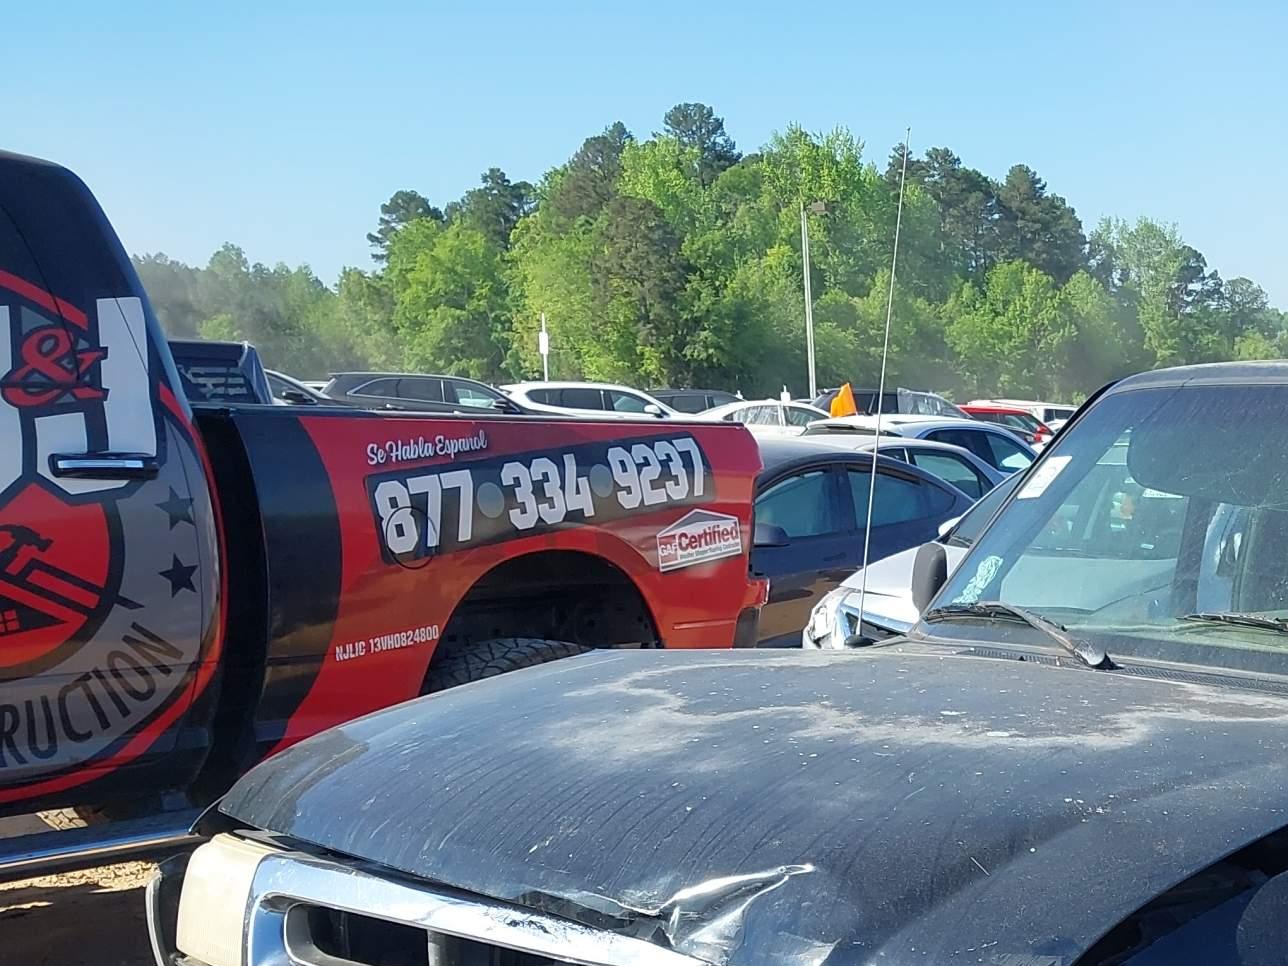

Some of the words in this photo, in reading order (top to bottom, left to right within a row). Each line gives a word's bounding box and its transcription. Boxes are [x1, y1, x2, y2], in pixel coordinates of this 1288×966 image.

[366, 443, 386, 465] Se
[385, 436, 435, 463] Habla
[435, 429, 488, 459] Espanol
[374, 469, 474, 554] 877
[501, 454, 595, 530] 334
[607, 437, 706, 510] 9237
[660, 543, 678, 557] GAF
[678, 521, 739, 552] Certified
[369, 624, 440, 653] 13VH0824800
